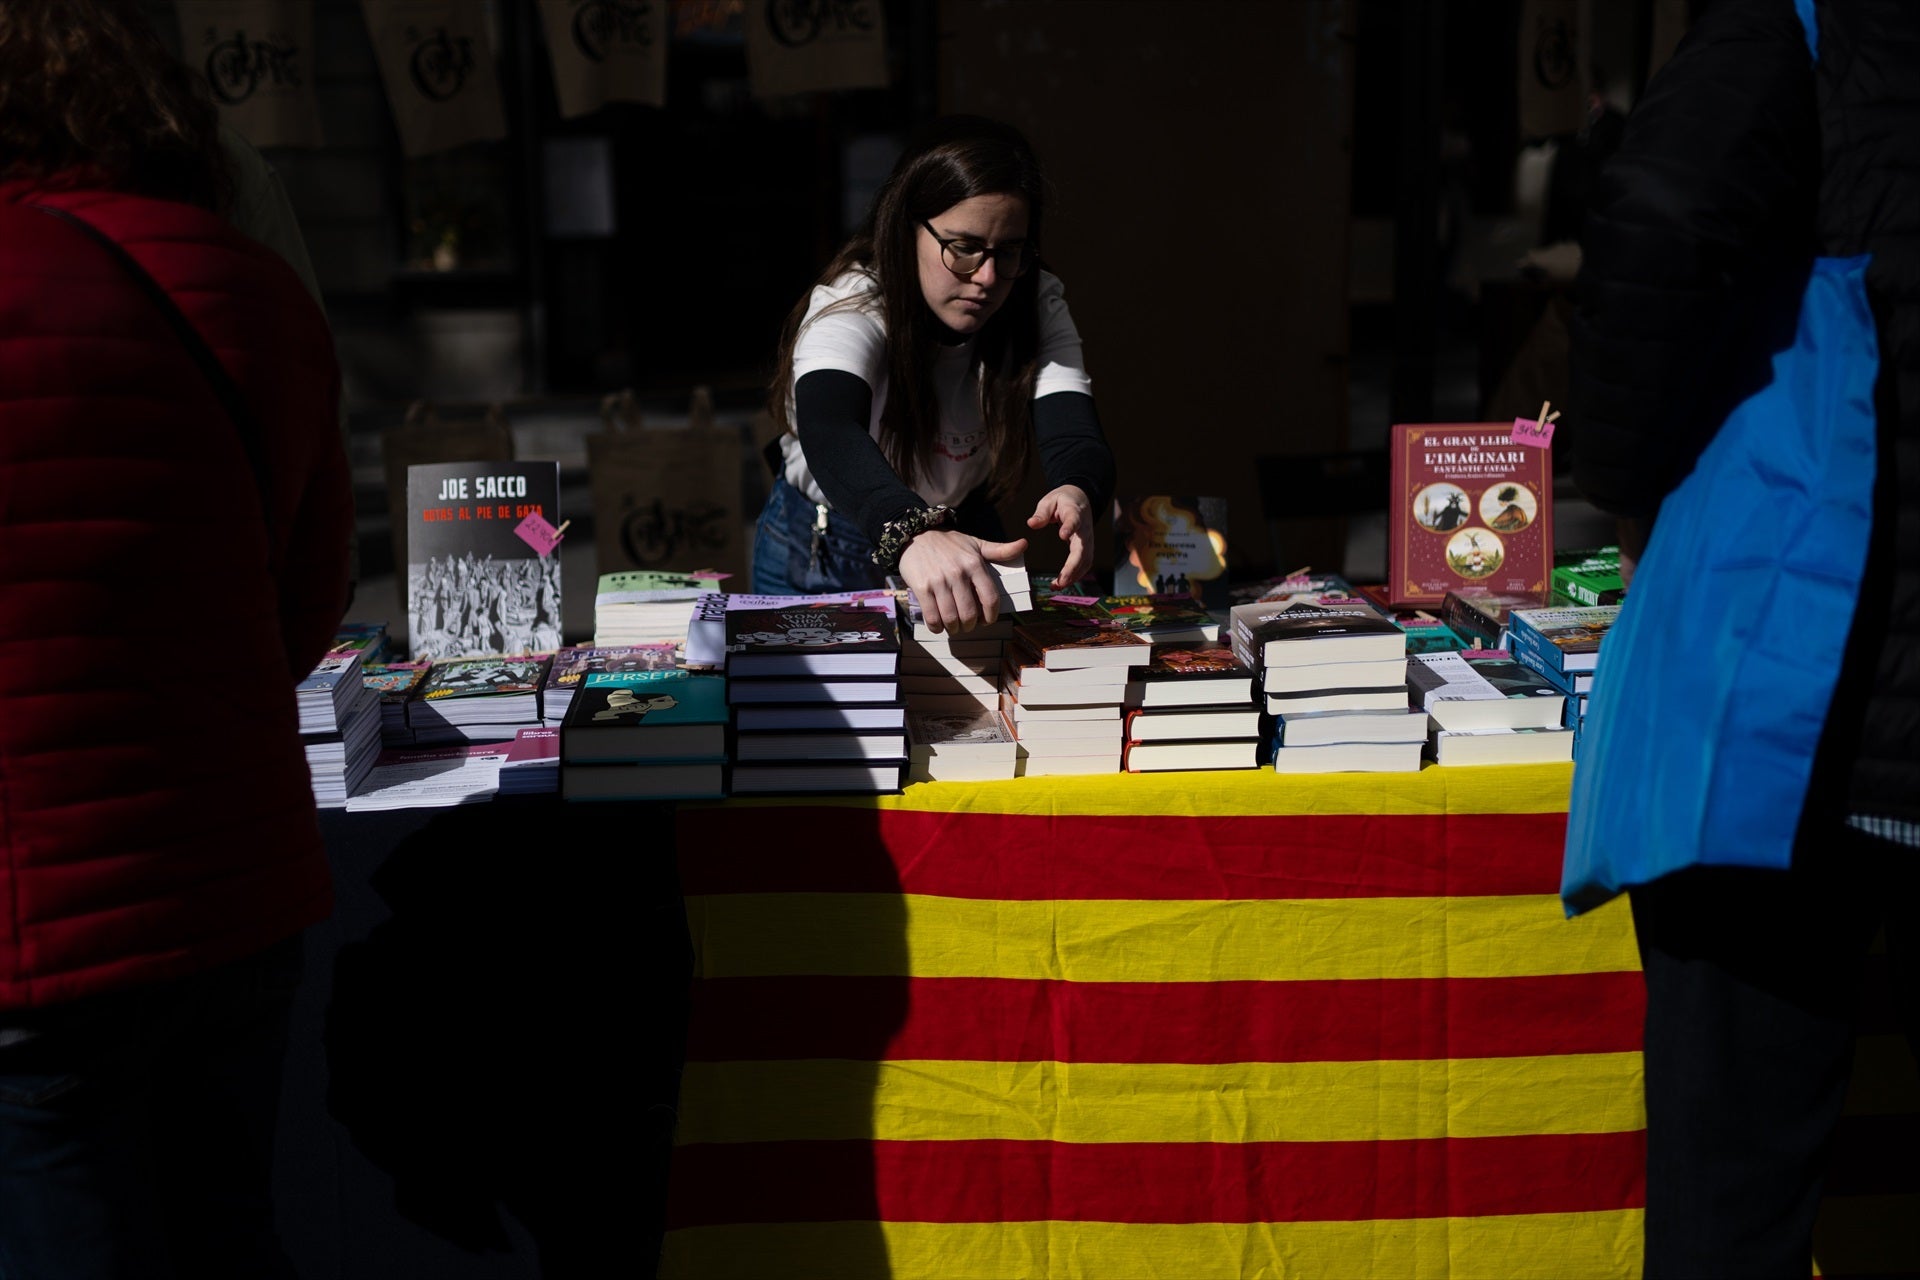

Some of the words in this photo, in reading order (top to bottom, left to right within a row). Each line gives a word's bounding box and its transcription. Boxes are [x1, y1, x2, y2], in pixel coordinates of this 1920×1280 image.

[1424, 436, 1441, 447] EL
[1443, 435, 1477, 447] GRAN
[1480, 435, 1517, 446] LLIB
[1424, 452, 1525, 465] L'IMAGINARI
[1433, 463, 1481, 474] FANTÀSTIC
[1484, 463, 1516, 473] CATALÀ
[438, 478, 469, 500] JOE
[475, 476, 526, 499] SACCO
[423, 507, 454, 522] NOTAS
[458, 506, 471, 520] AL
[477, 505, 493, 519] PIE
[498, 504, 511, 519] DE
[596, 671, 720, 684] PERSEPO
